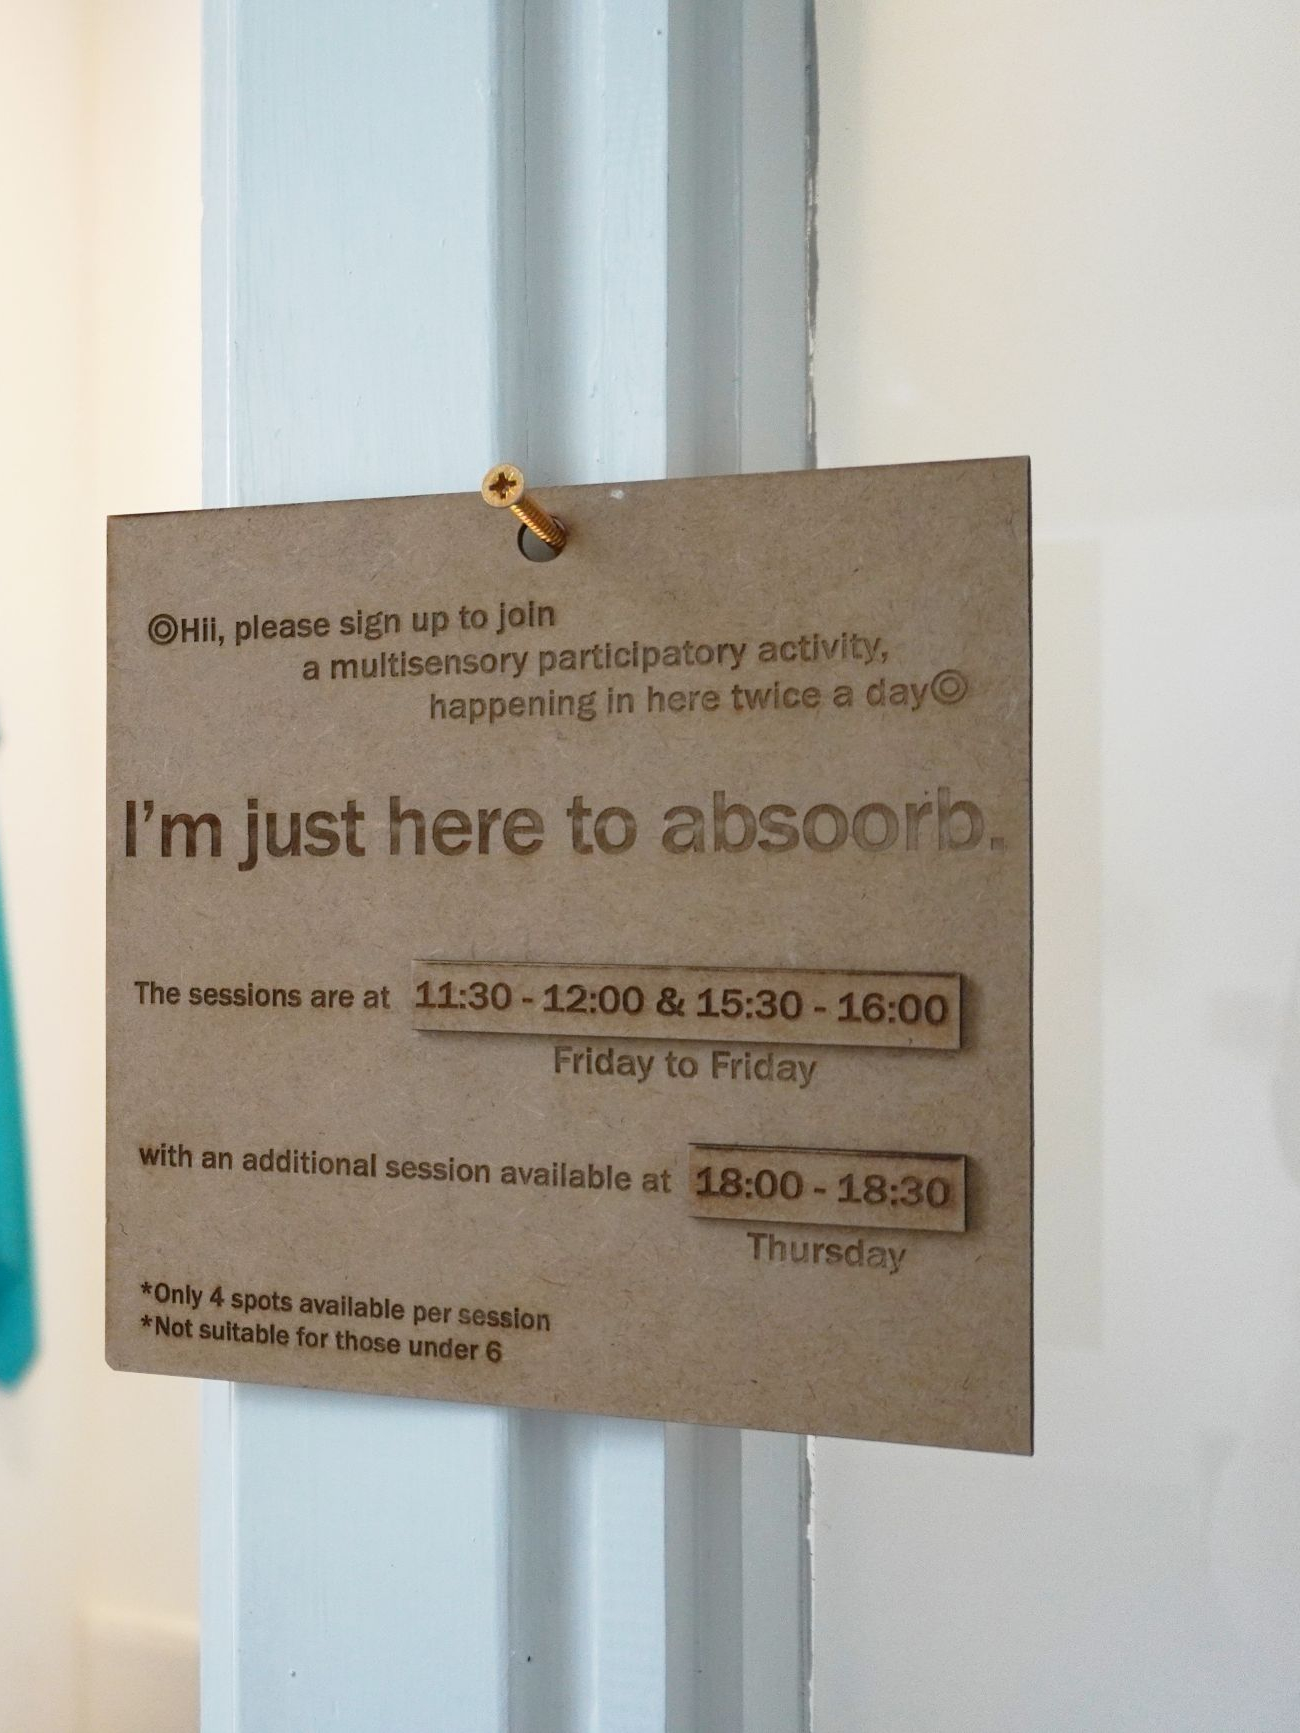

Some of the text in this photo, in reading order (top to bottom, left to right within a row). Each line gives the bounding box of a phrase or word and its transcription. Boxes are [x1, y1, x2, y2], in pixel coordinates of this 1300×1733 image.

[235, 616, 330, 645] please
[340, 610, 400, 641] sign
[412, 607, 450, 636] up
[459, 605, 488, 629] to
[497, 602, 555, 635] join
[302, 633, 888, 680] a multisensory participatory activity,
[430, 687, 596, 724] happening
[608, 687, 634, 714] in
[647, 686, 720, 712] here
[732, 682, 821, 711] twice
[833, 686, 853, 707] a
[126, 786, 1007, 871] I’m just here to absoorb.
[134, 981, 181, 1005] The
[189, 983, 301, 1007] sessions
[310, 990, 355, 1008] are
[363, 985, 390, 1009] at
[415, 981, 512, 1010] 11:30
[543, 984, 644, 1015] 12:00
[656, 987, 685, 1017] &
[697, 988, 803, 1020] 15:30
[837, 992, 949, 1026] 16:00
[553, 1046, 817, 1088] Friday to Friday
[139, 1144, 192, 1168] with
[201, 1151, 233, 1169] an
[242, 1149, 377, 1177] additional
[385, 1157, 490, 1183] session
[500, 1162, 631, 1191] available
[642, 1167, 671, 1193] at
[695, 1166, 802, 1200] 18:00
[837, 1174, 950, 1208] 18:30
[747, 1232, 905, 1274] Thursday
[210, 1287, 224, 1307] 4
[231, 1288, 293, 1312] spots
[300, 1295, 404, 1319] available
[414, 1307, 451, 1325] per
[458, 1306, 551, 1331] session
[199, 1319, 289, 1345] suitable
[296, 1327, 327, 1349] for
[336, 1331, 400, 1354] those
[409, 1336, 478, 1361] under
[486, 1341, 502, 1362] 6
